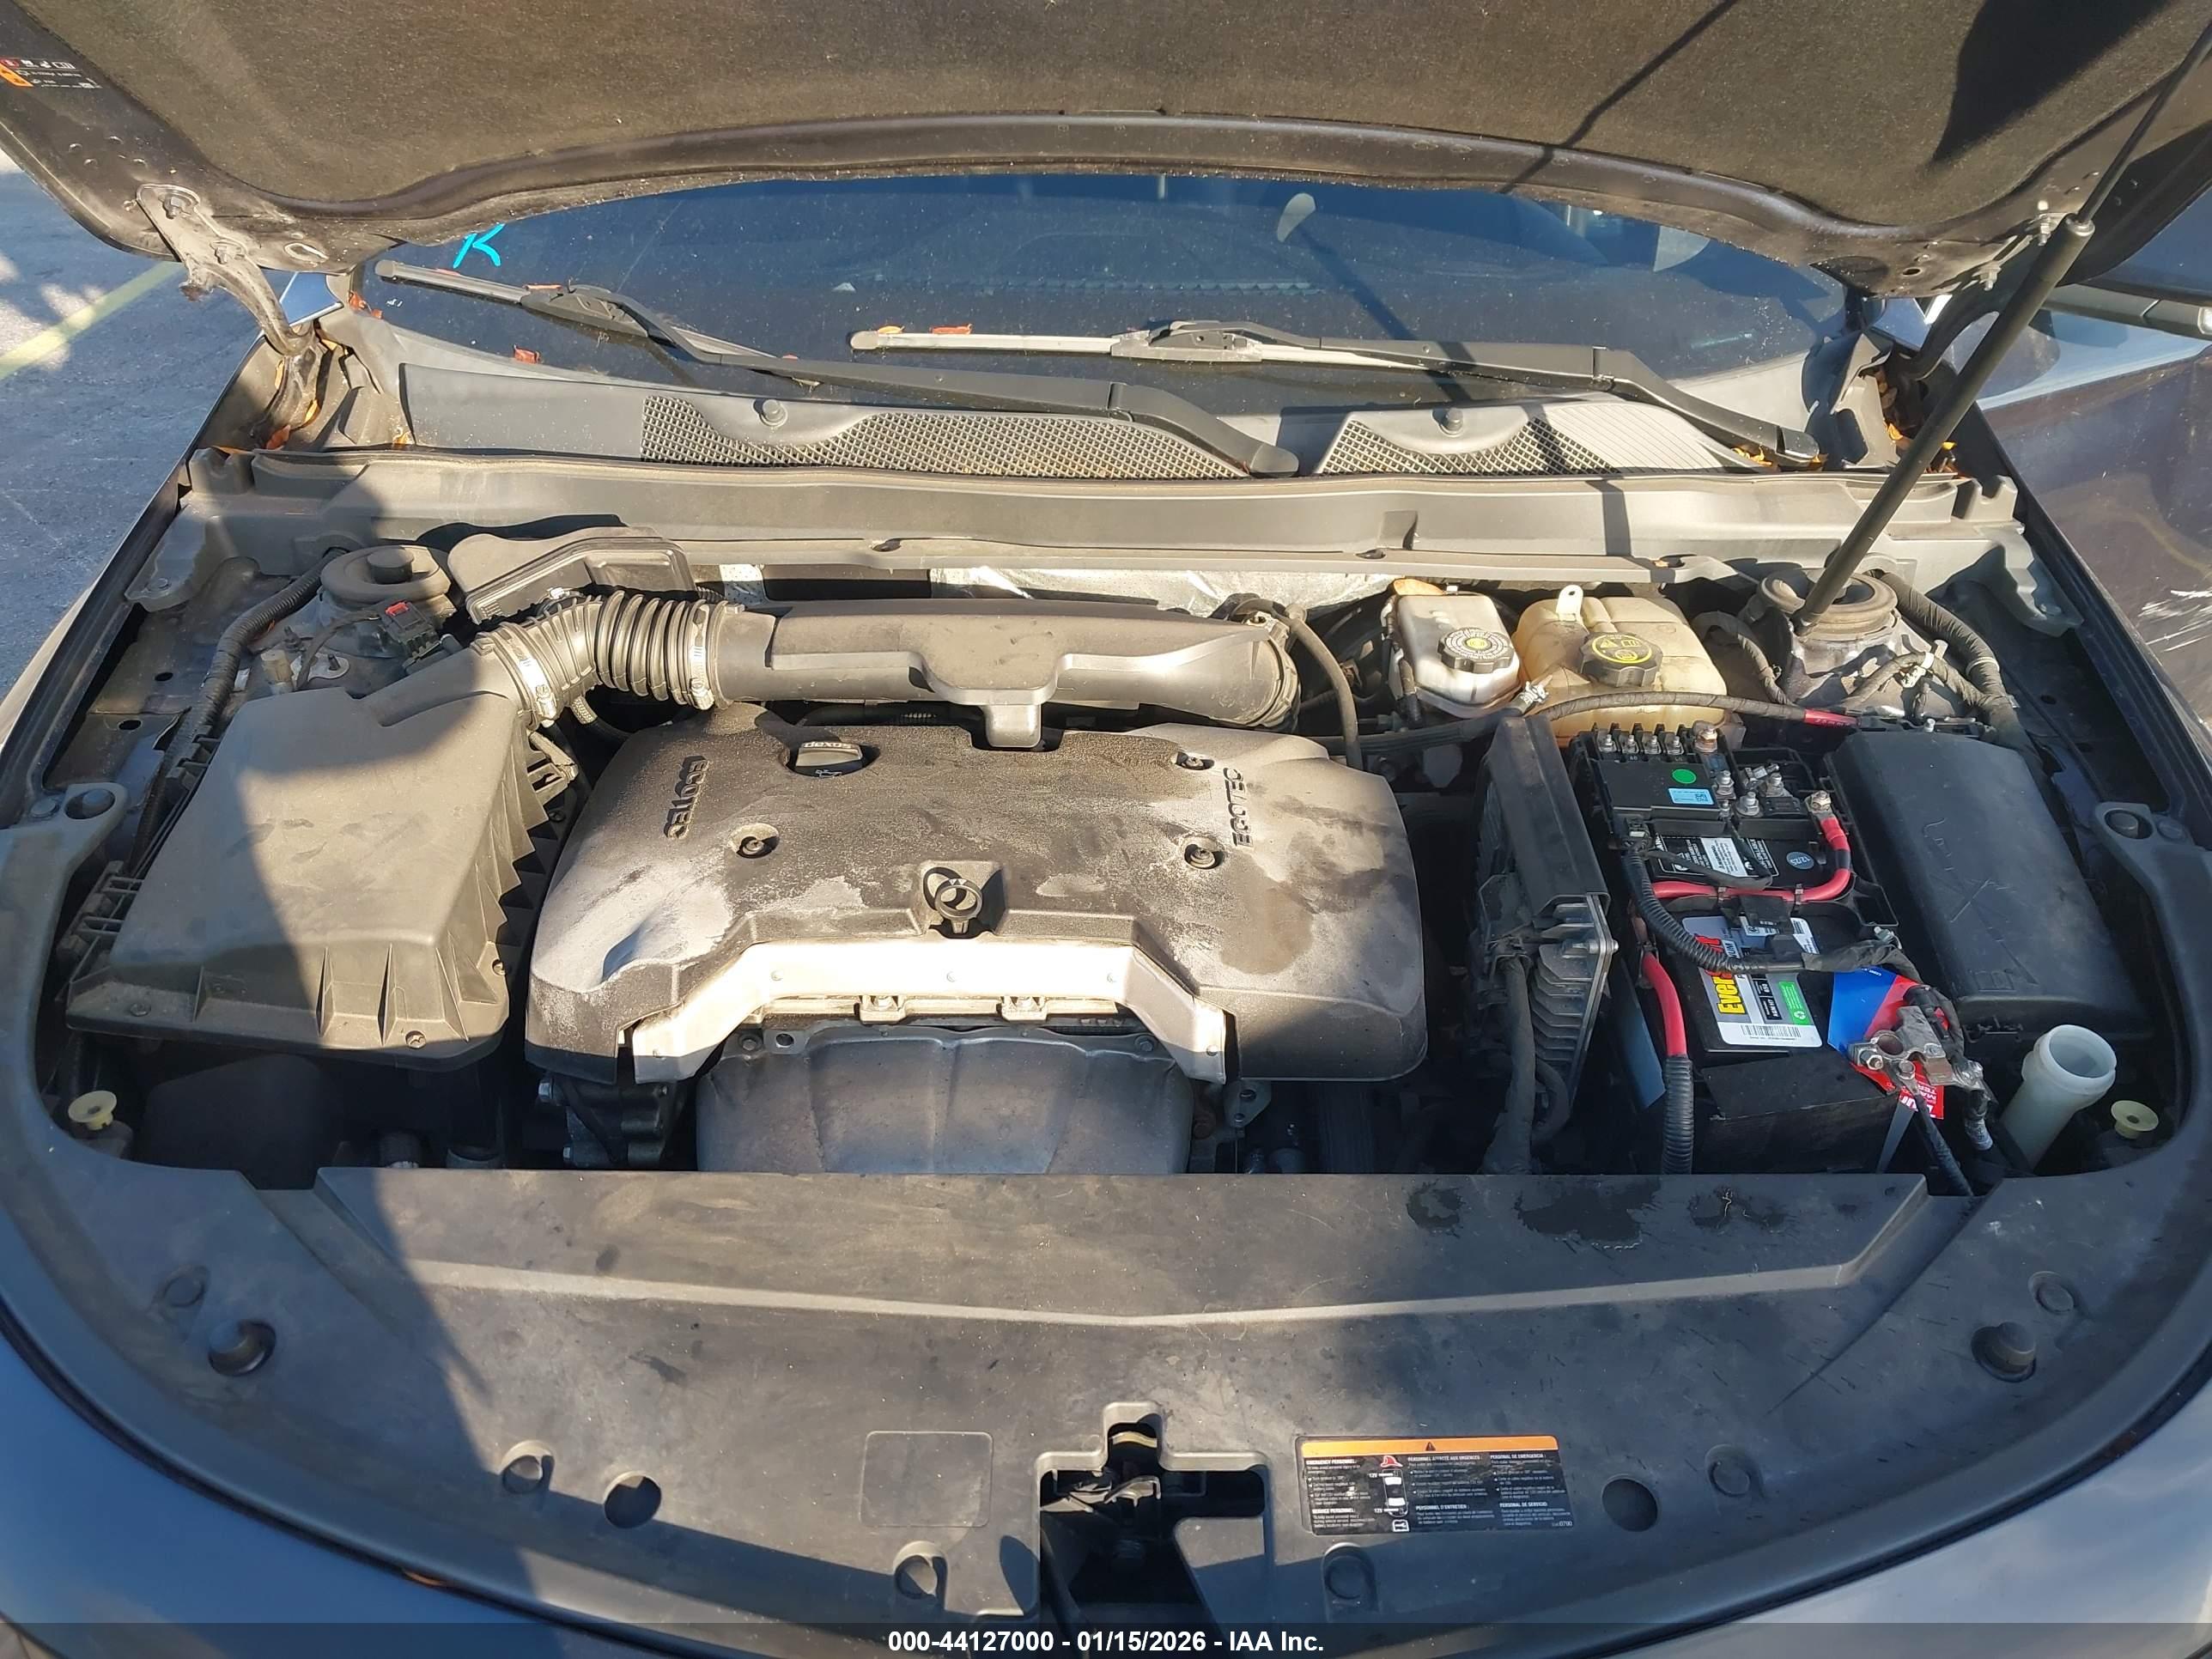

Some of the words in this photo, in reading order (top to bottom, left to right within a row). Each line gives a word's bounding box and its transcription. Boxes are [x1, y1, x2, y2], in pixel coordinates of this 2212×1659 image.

[667, 759, 710, 840] ECOTEC
[1223, 767, 1254, 848] ECOTEC
[1790, 854, 1811, 866] 12/25
